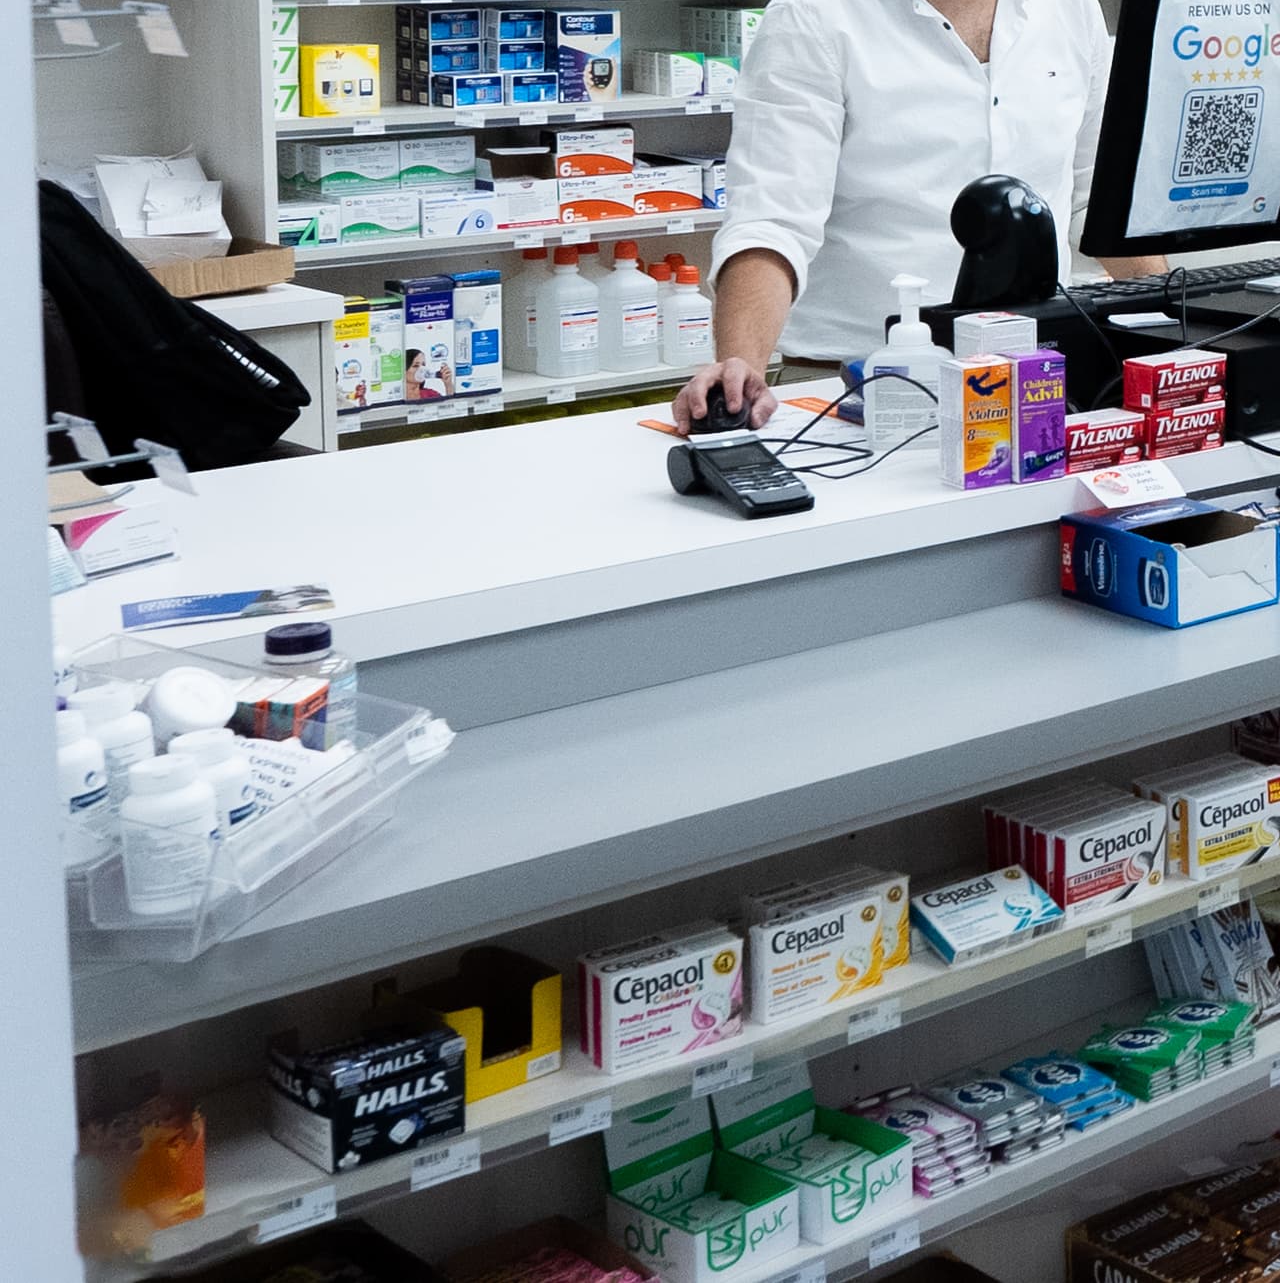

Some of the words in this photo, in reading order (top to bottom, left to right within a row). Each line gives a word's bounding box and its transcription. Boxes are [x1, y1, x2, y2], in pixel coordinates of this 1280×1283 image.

[1188, 4, 1232, 17] REVIEW
[1236, 3, 1250, 15] US
[1254, 3, 1271, 15] ON
[560, 161, 571, 178] 6
[1190, 186, 1209, 197] Scan
[1210, 185, 1228, 196] me!
[562, 207, 574, 224] 6
[634, 198, 646, 215] 6
[475, 215, 485, 229] 6
[1023, 378, 1063, 390] Children's
[1158, 364, 1218, 389] TYLENOL
[1023, 386, 1064, 403] Advil
[968, 407, 1009, 421] Motrin
[1156, 412, 1217, 437] TYLENOL
[967, 428, 976, 441] 8
[1070, 426, 1135, 450] TYLENOL
[1097, 539, 1106, 590] Vaseline
[1200, 793, 1265, 829] Cēpacol
[1079, 820, 1152, 864] Cēpacol
[1204, 834, 1223, 847] EXTRA
[1224, 826, 1254, 843] STRENGTH
[1073, 872, 1092, 886] EXTRA
[1093, 862, 1123, 879] STRENGTH
[771, 914, 845, 955] Cēpacol
[614, 957, 706, 1005] Cēpacol
[1101, 1205, 1169, 1243] CARAMILK
[1134, 1228, 1201, 1268] CARAMILK
